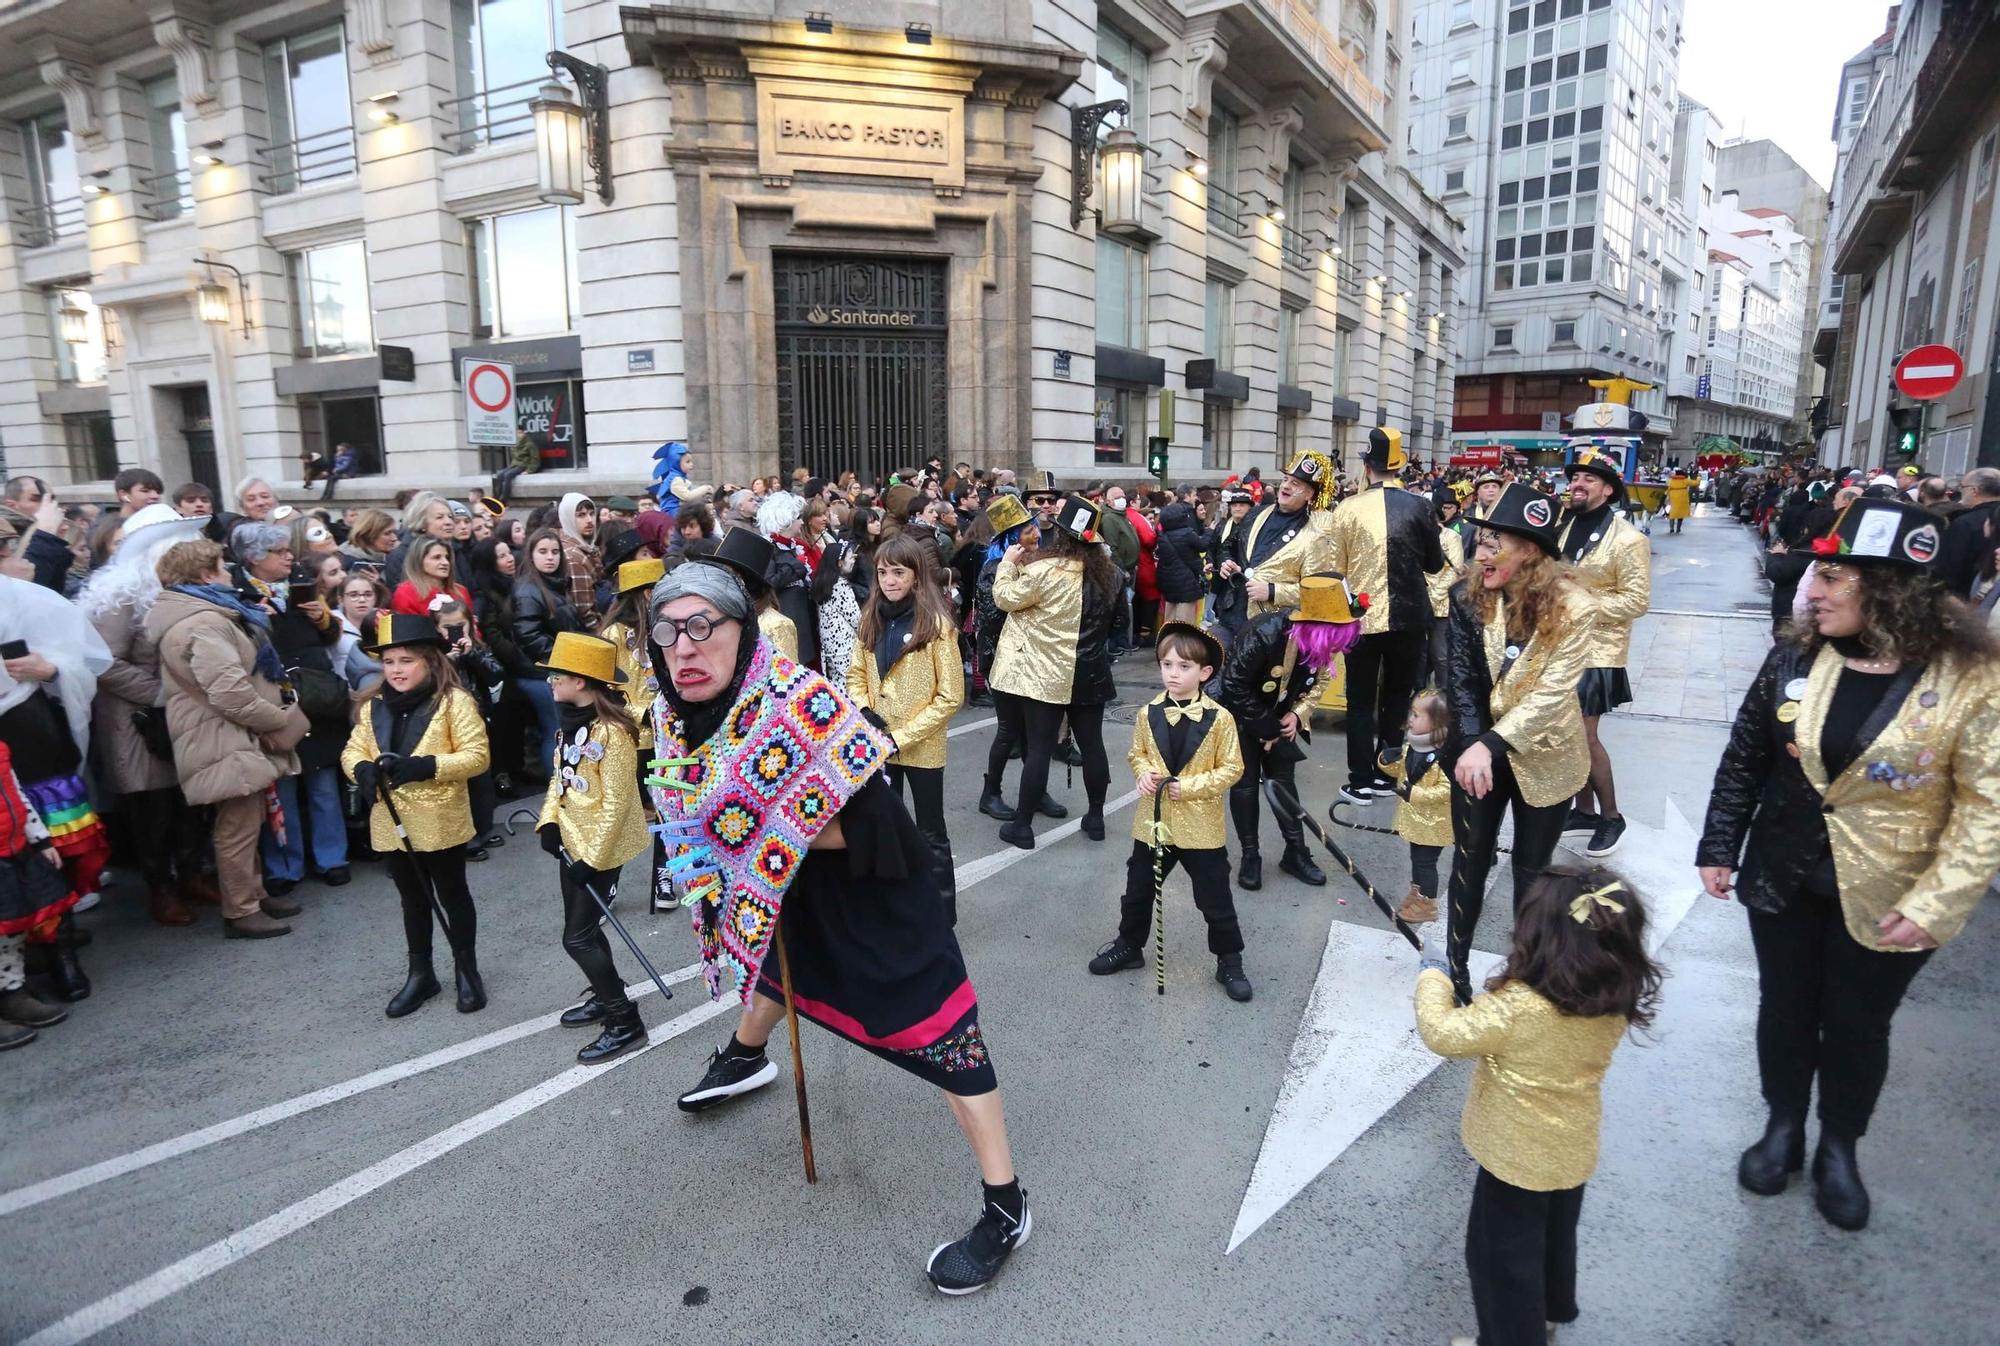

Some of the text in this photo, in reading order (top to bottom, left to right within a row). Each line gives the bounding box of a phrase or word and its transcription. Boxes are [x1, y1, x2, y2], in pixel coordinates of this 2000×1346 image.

[781, 119, 944, 148] BANCO PASTOR
[831, 308, 917, 326] Santander
[516, 395, 555, 415] Work
